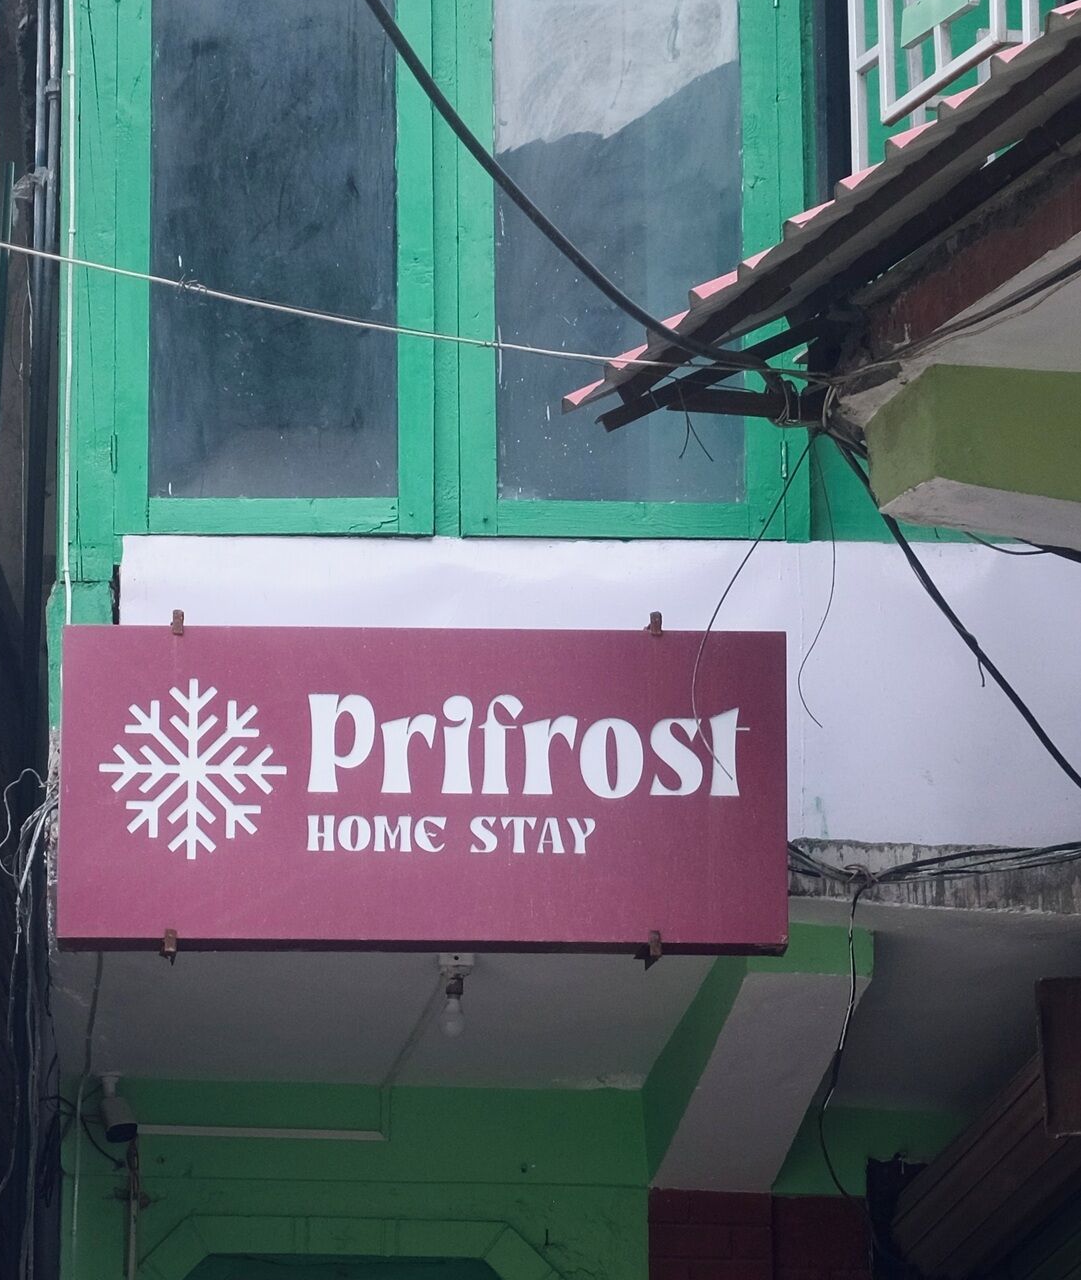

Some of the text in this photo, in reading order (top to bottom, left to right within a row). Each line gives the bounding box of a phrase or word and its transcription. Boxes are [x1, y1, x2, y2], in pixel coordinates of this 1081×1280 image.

[307, 694, 750, 799] Prifrost
[306, 815, 596, 854] HOME STAY
